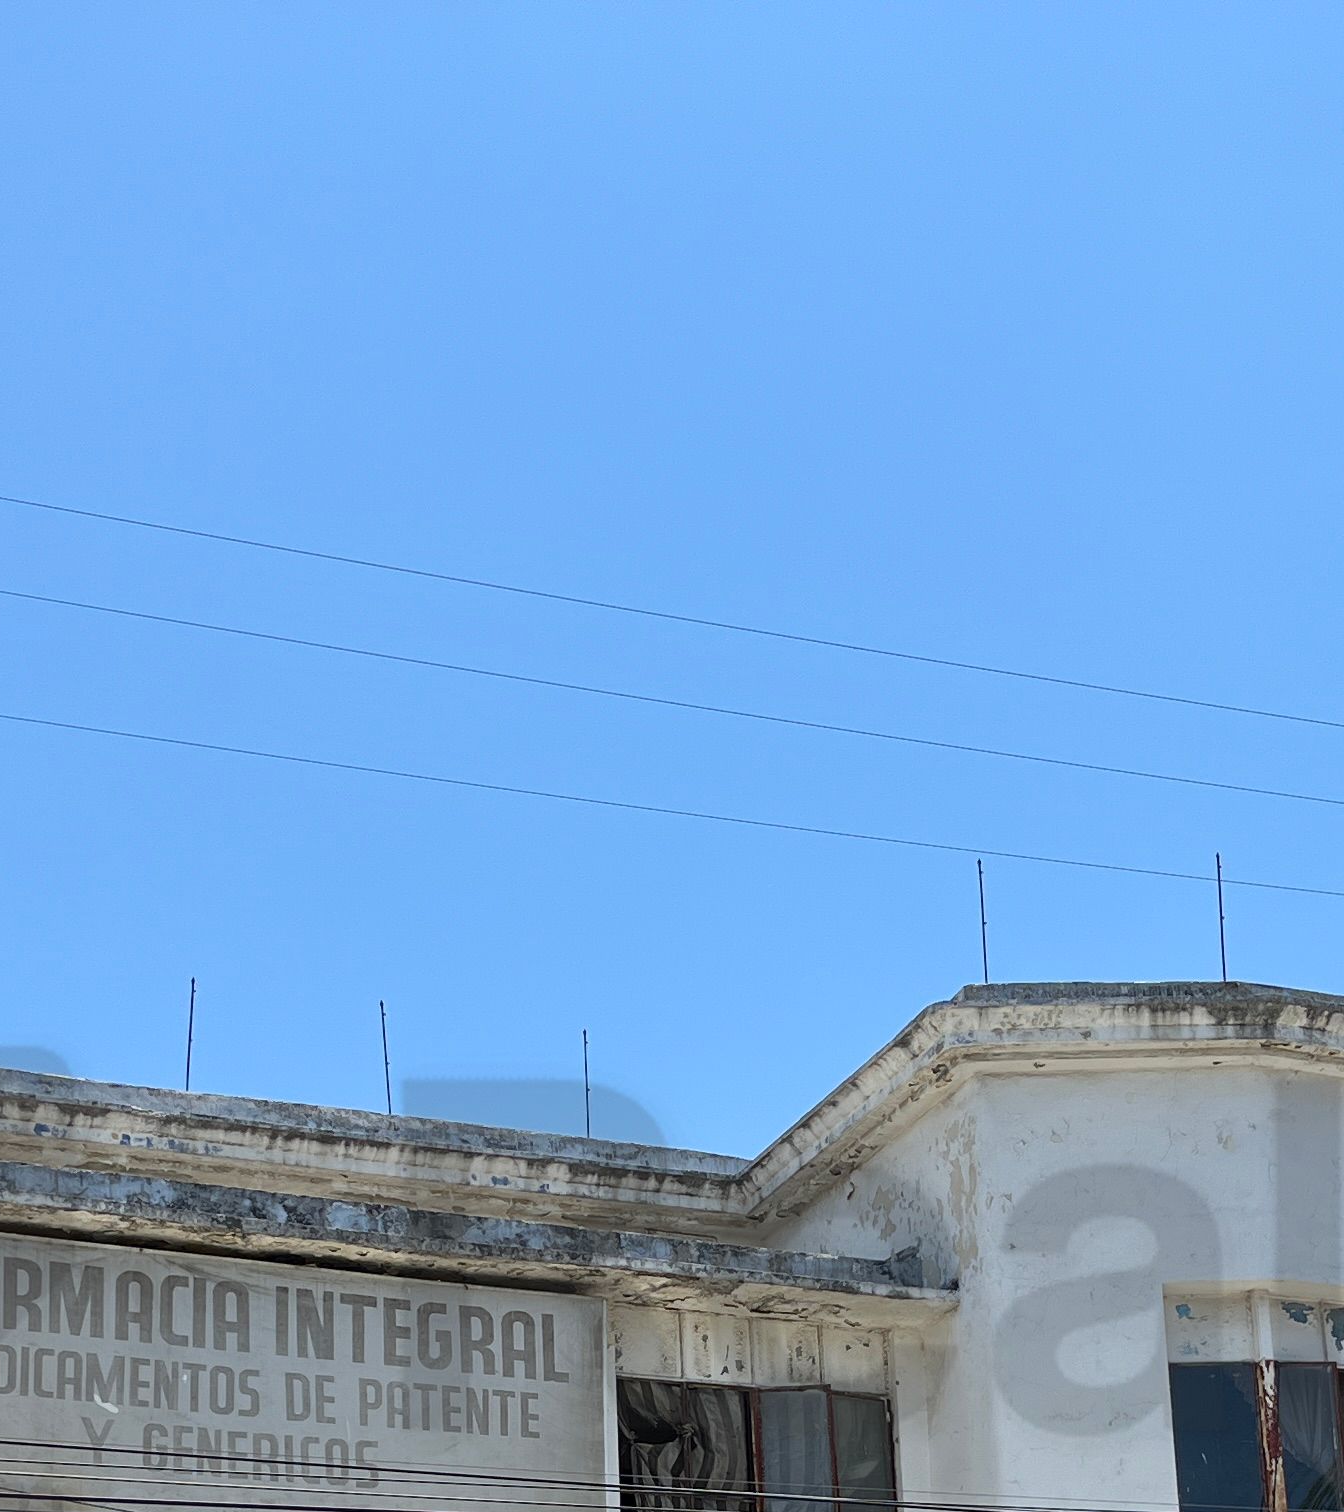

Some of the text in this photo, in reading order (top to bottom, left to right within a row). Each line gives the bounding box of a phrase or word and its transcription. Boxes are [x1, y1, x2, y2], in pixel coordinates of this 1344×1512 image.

[275, 1286, 571, 1384] INTEGRAL
[285, 1372, 337, 1425] DE
[361, 1378, 541, 1440] PATENTE
[81, 1416, 381, 1490] Y GENERICOS
